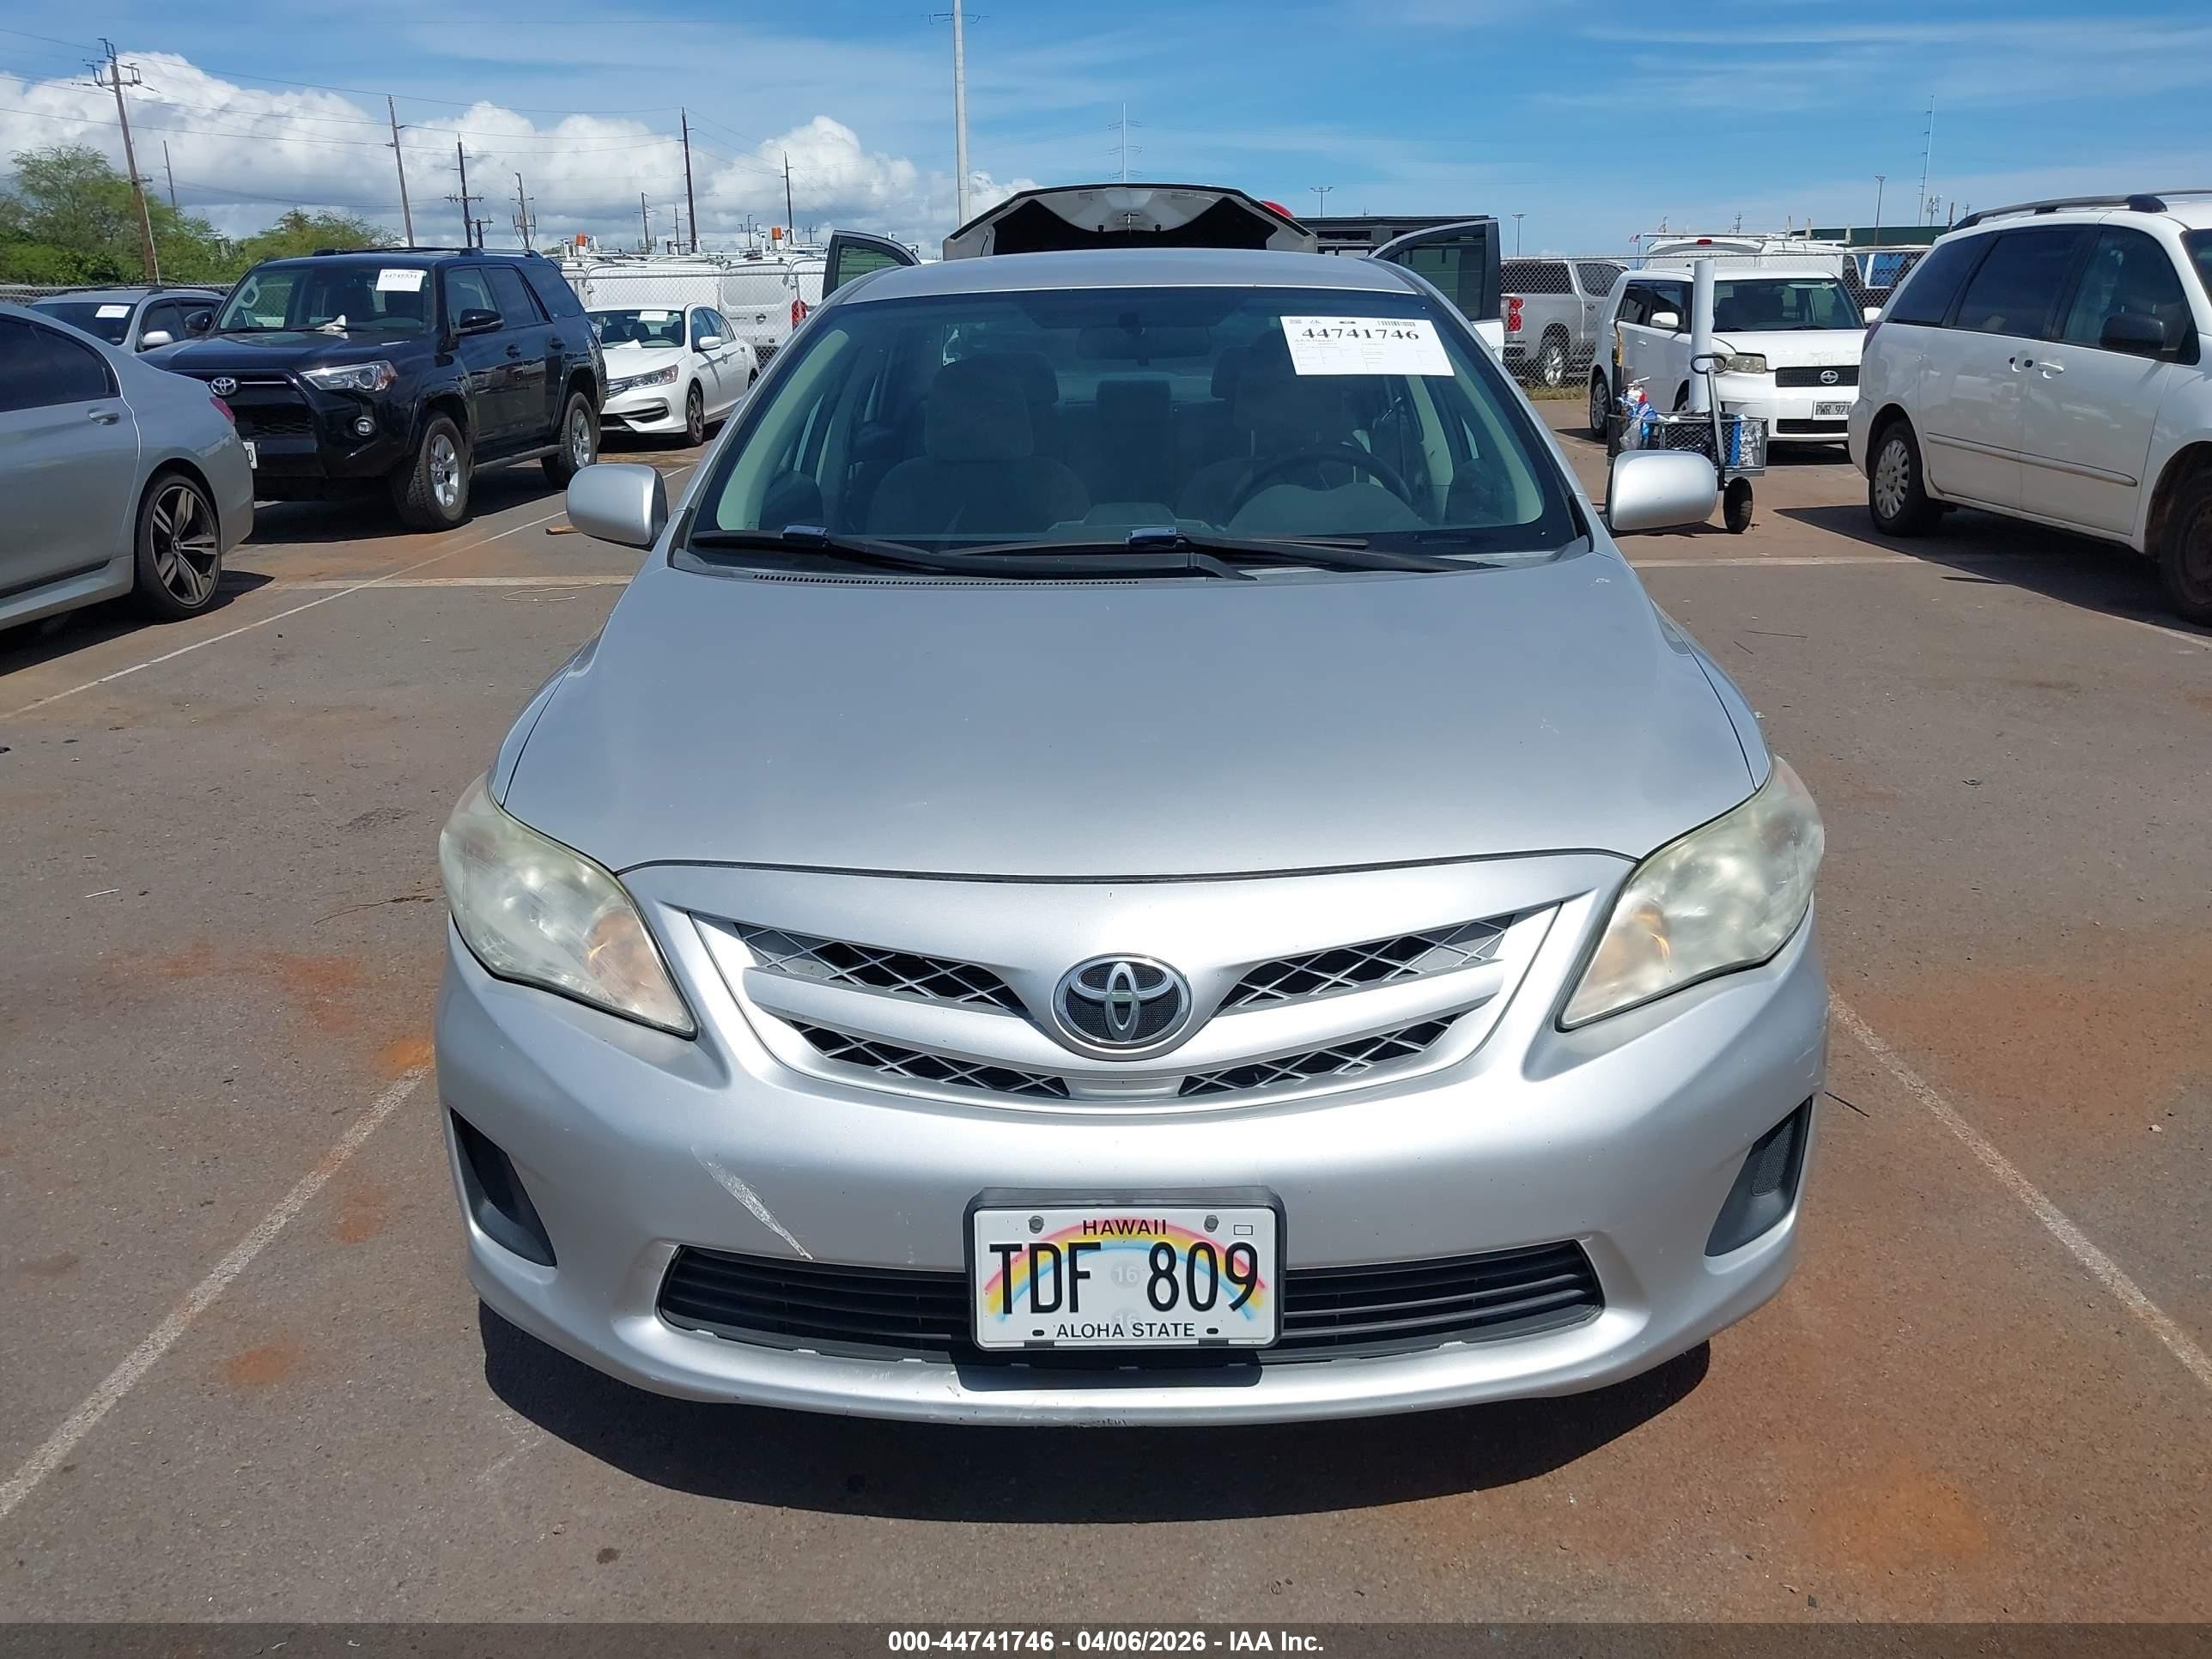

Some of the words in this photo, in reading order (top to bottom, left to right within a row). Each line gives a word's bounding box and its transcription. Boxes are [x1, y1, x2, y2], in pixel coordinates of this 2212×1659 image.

[1302, 328, 1419, 340] 44741746
[1082, 1218, 1167, 1236] HAWAII
[988, 1242, 1102, 1315] TDF
[1146, 1242, 1258, 1312] 809
[1055, 1323, 1125, 1339] ALOHA
[1131, 1322, 1196, 1338] STATE
